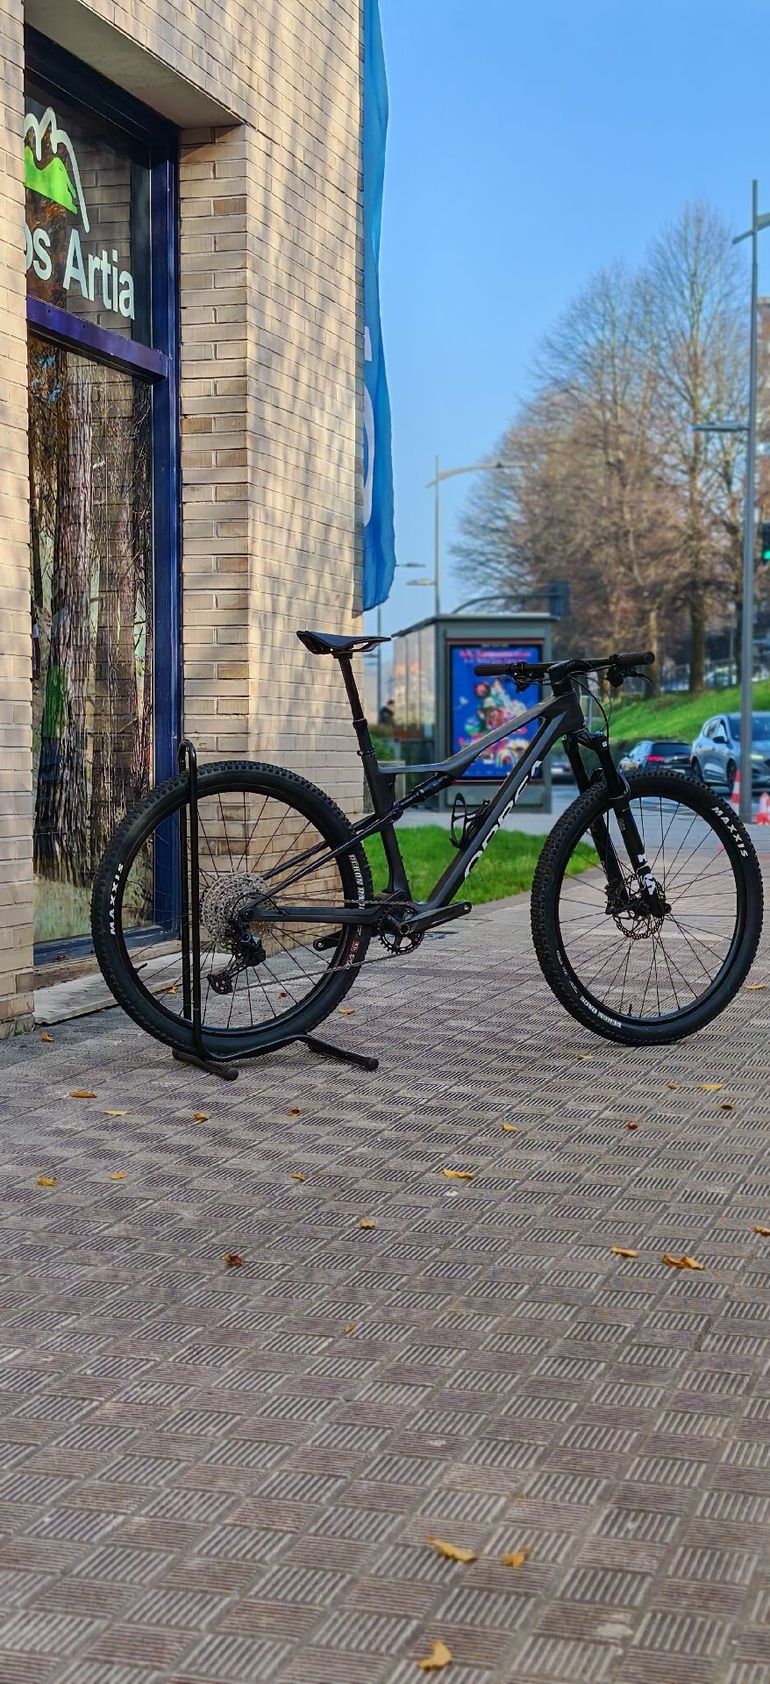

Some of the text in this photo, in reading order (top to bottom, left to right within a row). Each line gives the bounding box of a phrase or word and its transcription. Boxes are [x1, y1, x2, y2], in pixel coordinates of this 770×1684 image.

[62, 228, 135, 320] Artia
[711, 806, 749, 858] MAXXIS
[109, 863, 124, 935] MAXXIS
